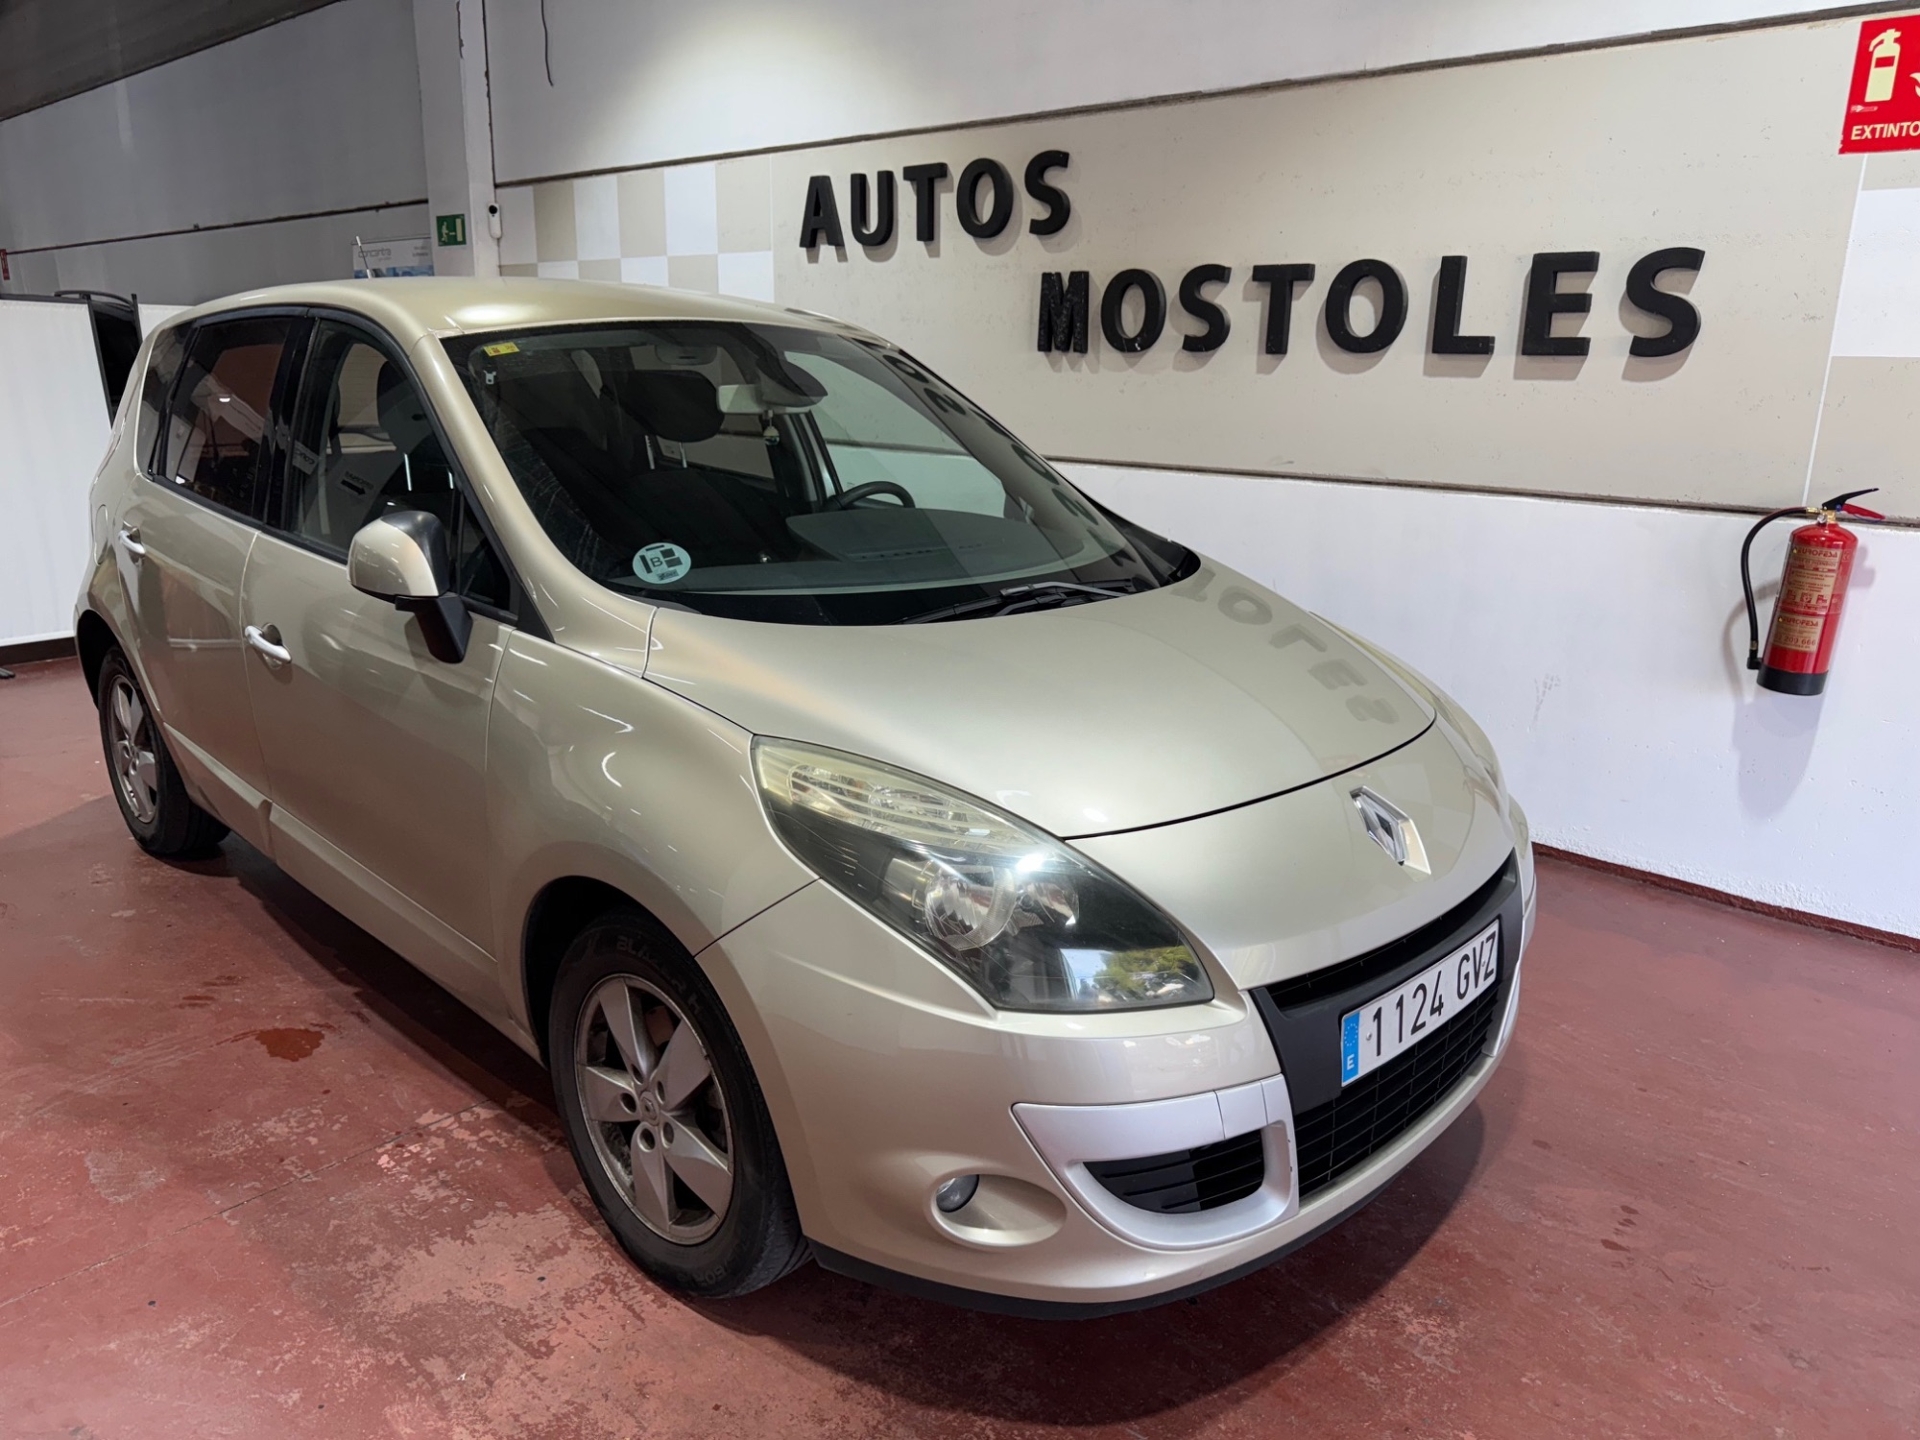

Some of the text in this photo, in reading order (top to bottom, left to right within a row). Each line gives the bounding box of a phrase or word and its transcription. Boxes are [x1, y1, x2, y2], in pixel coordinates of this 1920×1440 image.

[799, 149, 1072, 248] AUTOS
[1037, 247, 1705, 357] MOSTOLES
[650, 557, 663, 568] B
[1372, 931, 1497, 1057] 1124 GVZ
[1347, 1054, 1355, 1070] E
